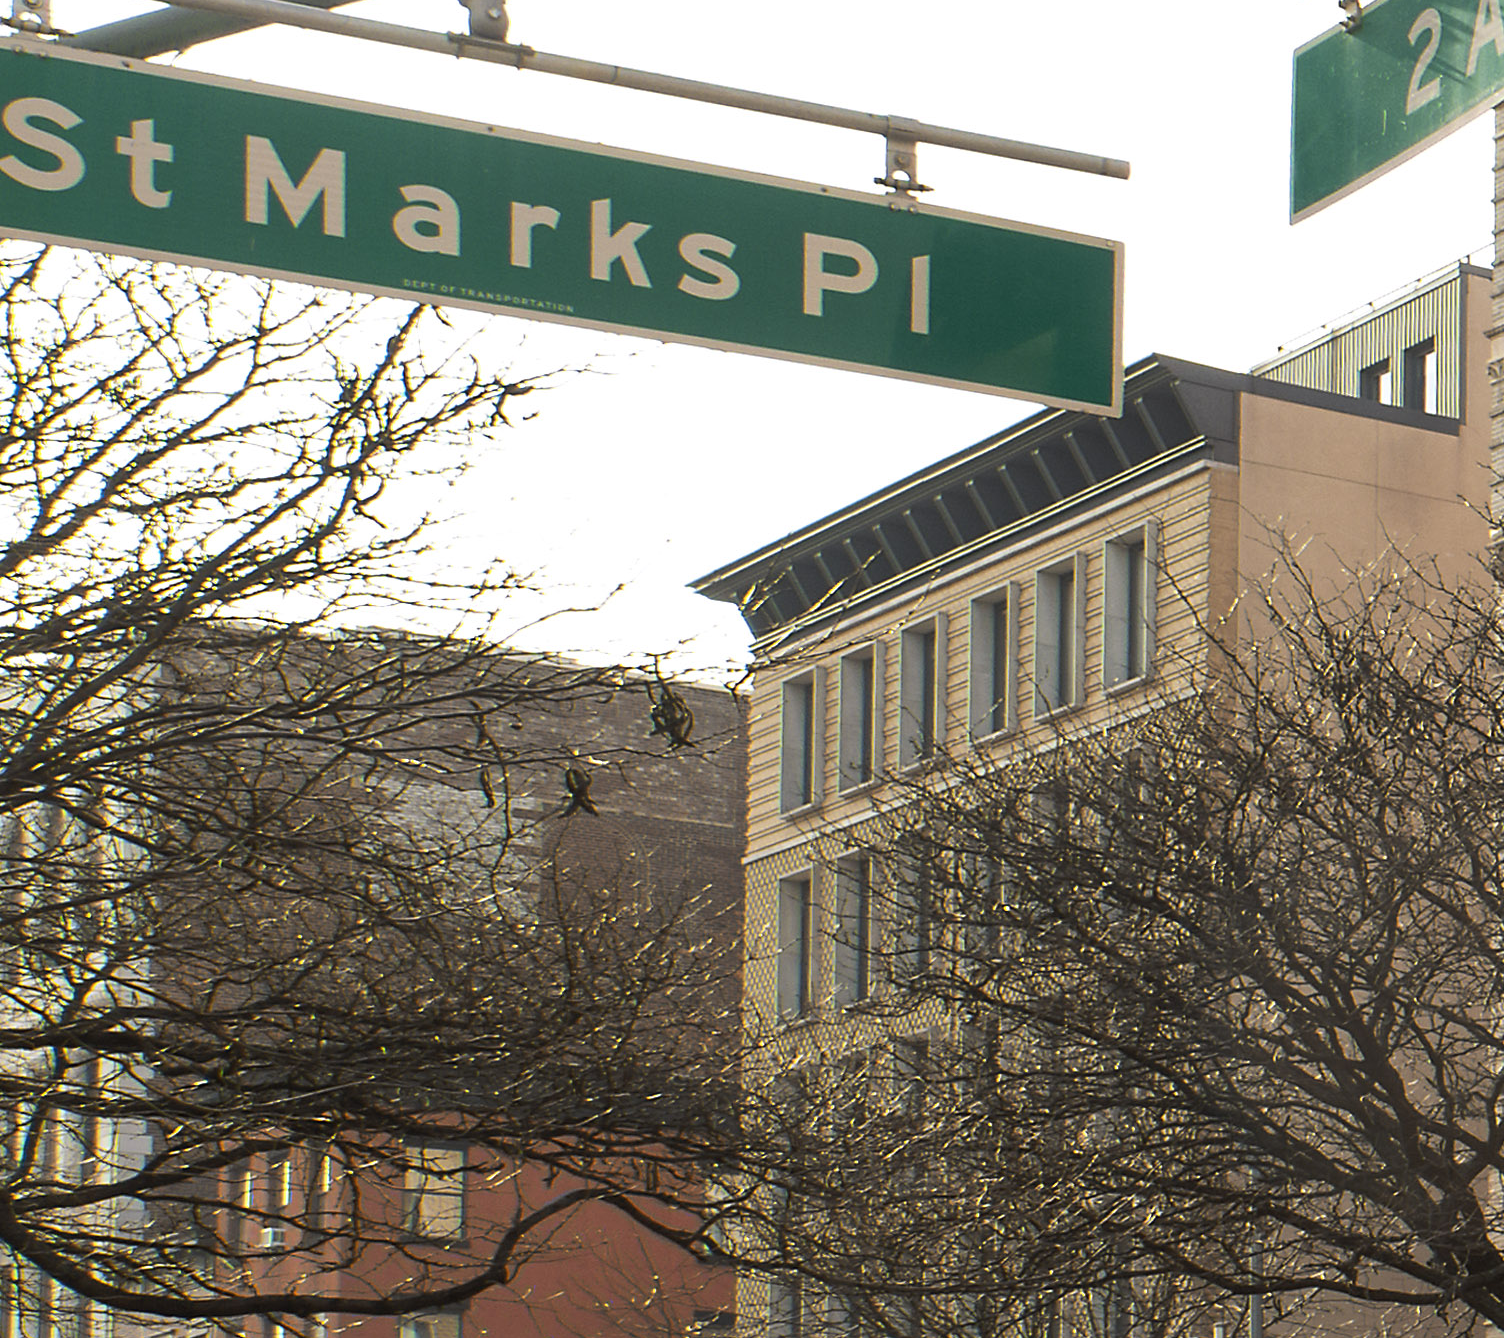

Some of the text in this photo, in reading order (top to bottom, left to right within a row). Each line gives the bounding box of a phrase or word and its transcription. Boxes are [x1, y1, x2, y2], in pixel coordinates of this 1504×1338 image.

[1405, 8, 1442, 116] 2
[0, 97, 931, 335] St Marks Pl
[403, 278, 574, 313] DEPT OF TRANSPORTATION
